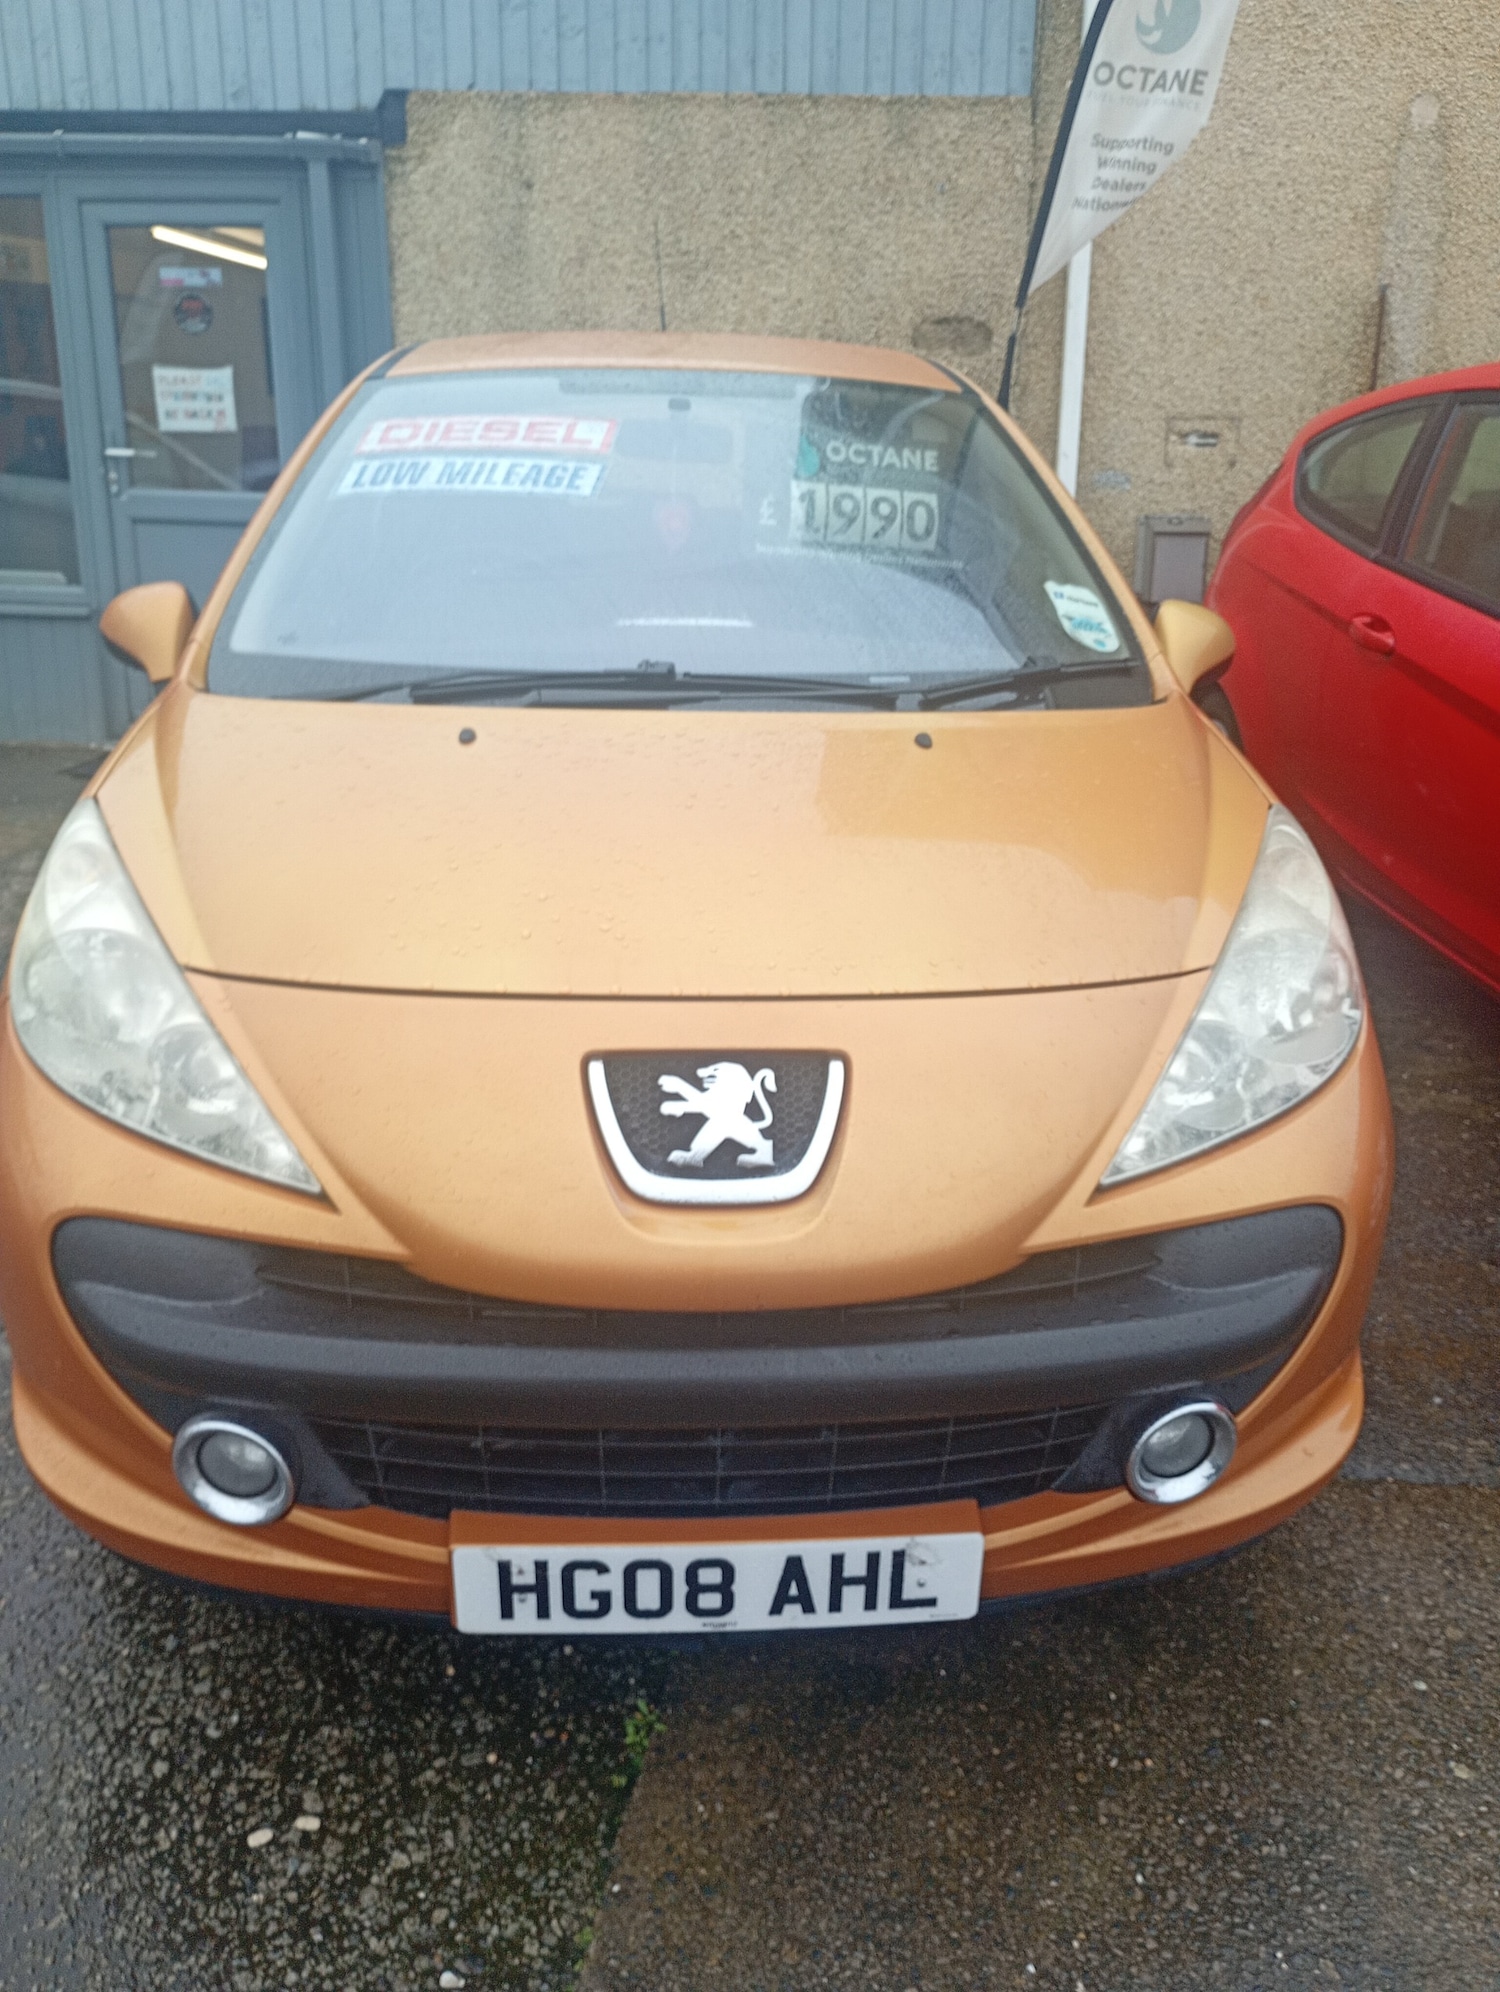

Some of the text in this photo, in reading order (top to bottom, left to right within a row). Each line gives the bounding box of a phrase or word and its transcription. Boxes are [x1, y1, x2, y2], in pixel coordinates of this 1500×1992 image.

[1093, 61, 1208, 96] OCTANE
[1091, 133, 1174, 156] Supporting
[1098, 156, 1157, 175] Winning
[1091, 176, 1146, 192] Dealers
[377, 420, 596, 446] DIESEL
[826, 440, 939, 472] OCTANE
[352, 461, 588, 491] LOW MILEAGE
[498, 1549, 938, 1620] HG08 AHL
